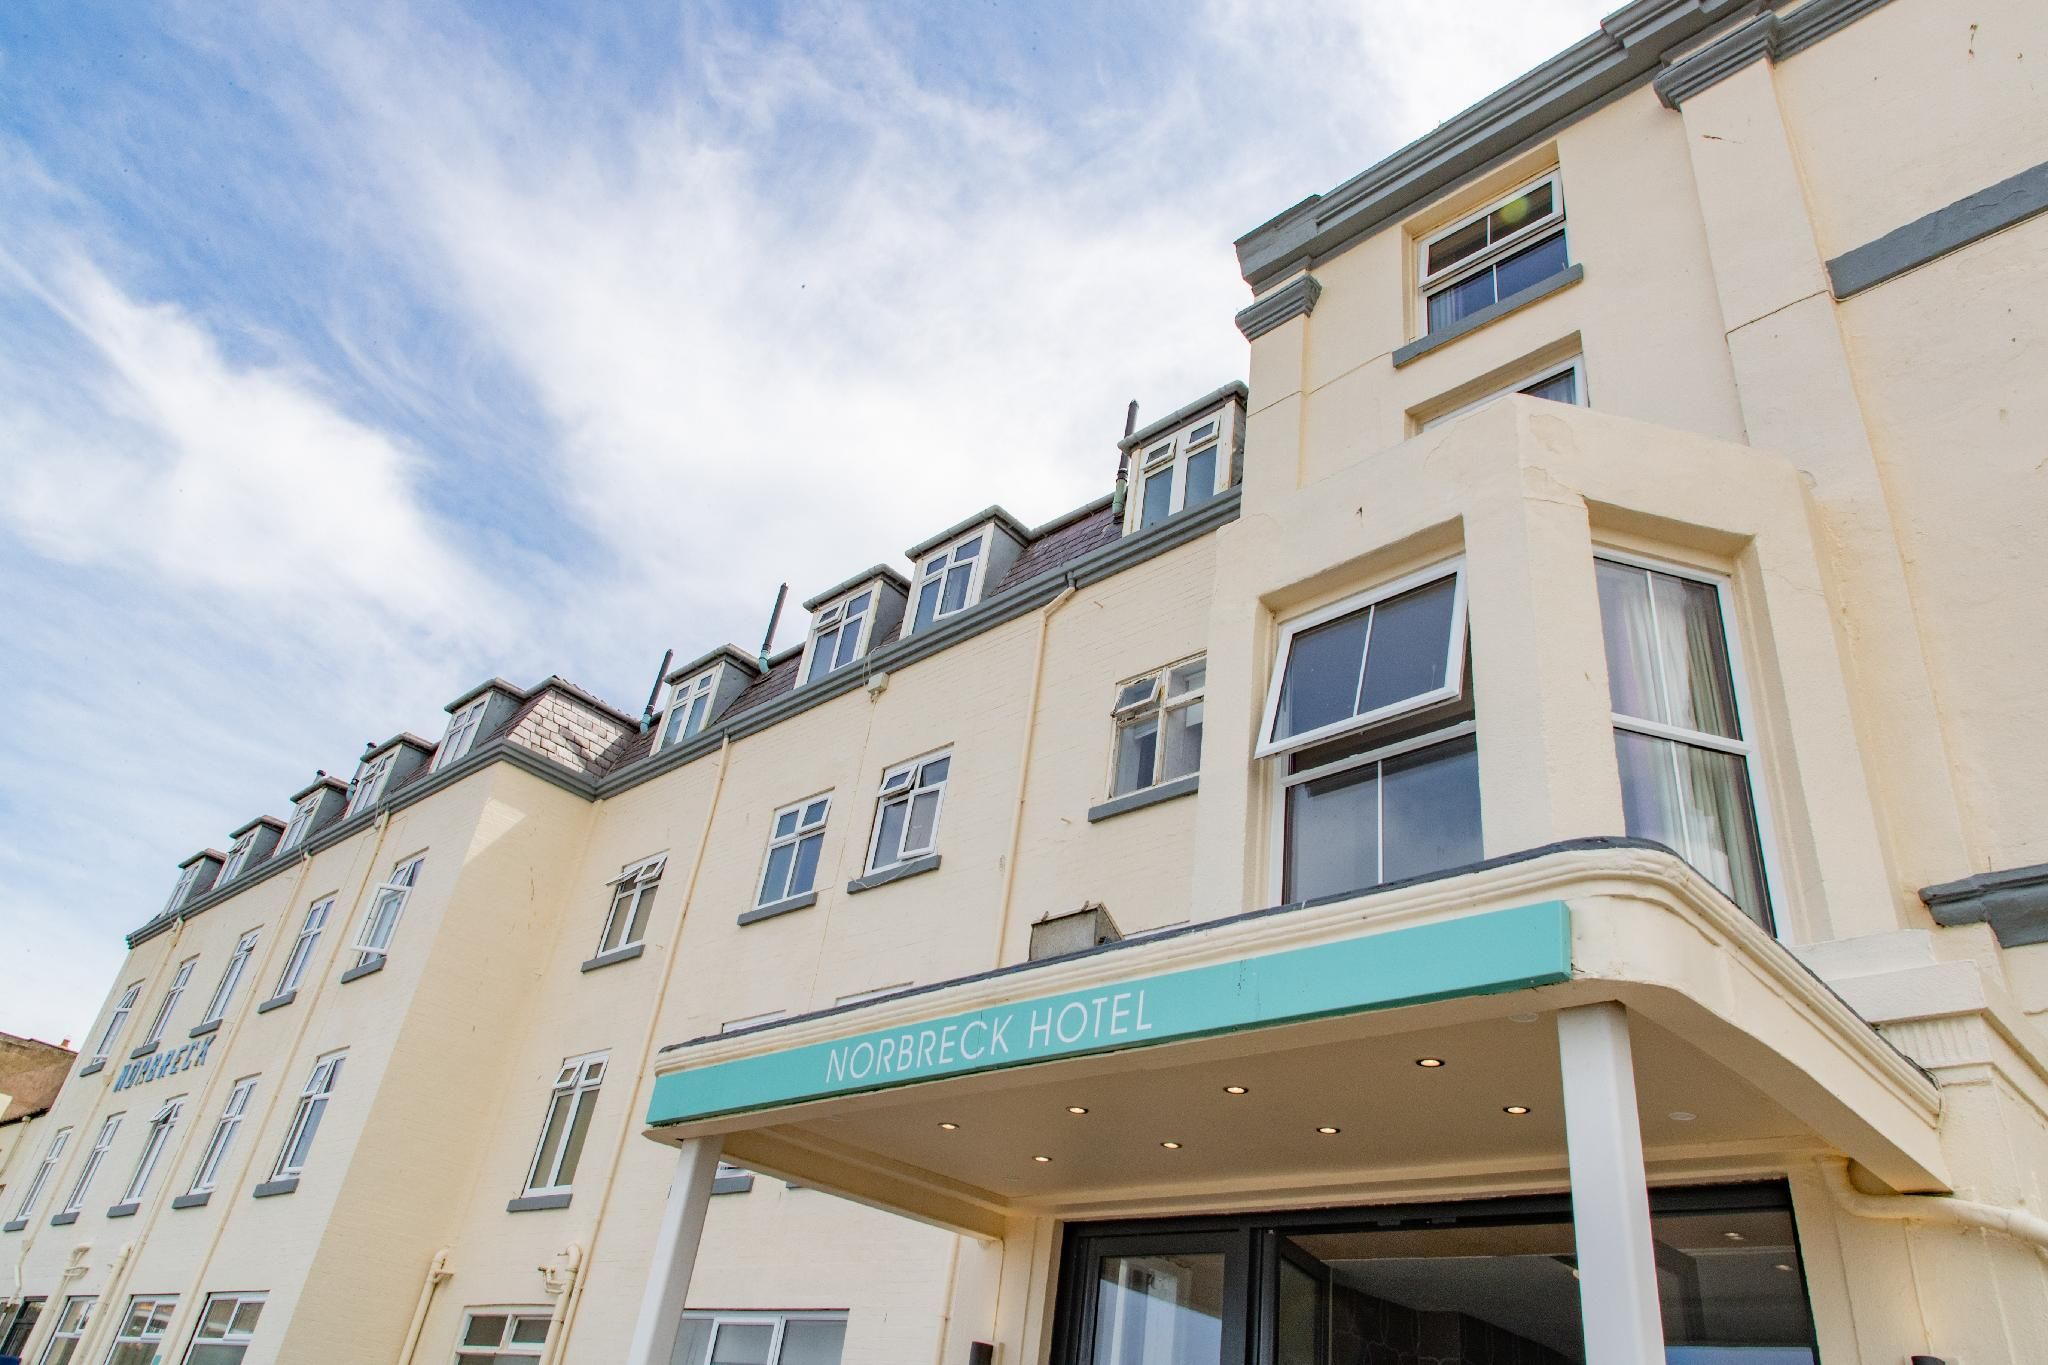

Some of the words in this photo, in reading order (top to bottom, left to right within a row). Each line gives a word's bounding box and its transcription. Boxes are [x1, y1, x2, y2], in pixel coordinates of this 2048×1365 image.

[112, 1034, 216, 1093] NORBRECK
[825, 1014, 1015, 1083] NORBRECK
[1028, 990, 1152, 1049] HOTEL
